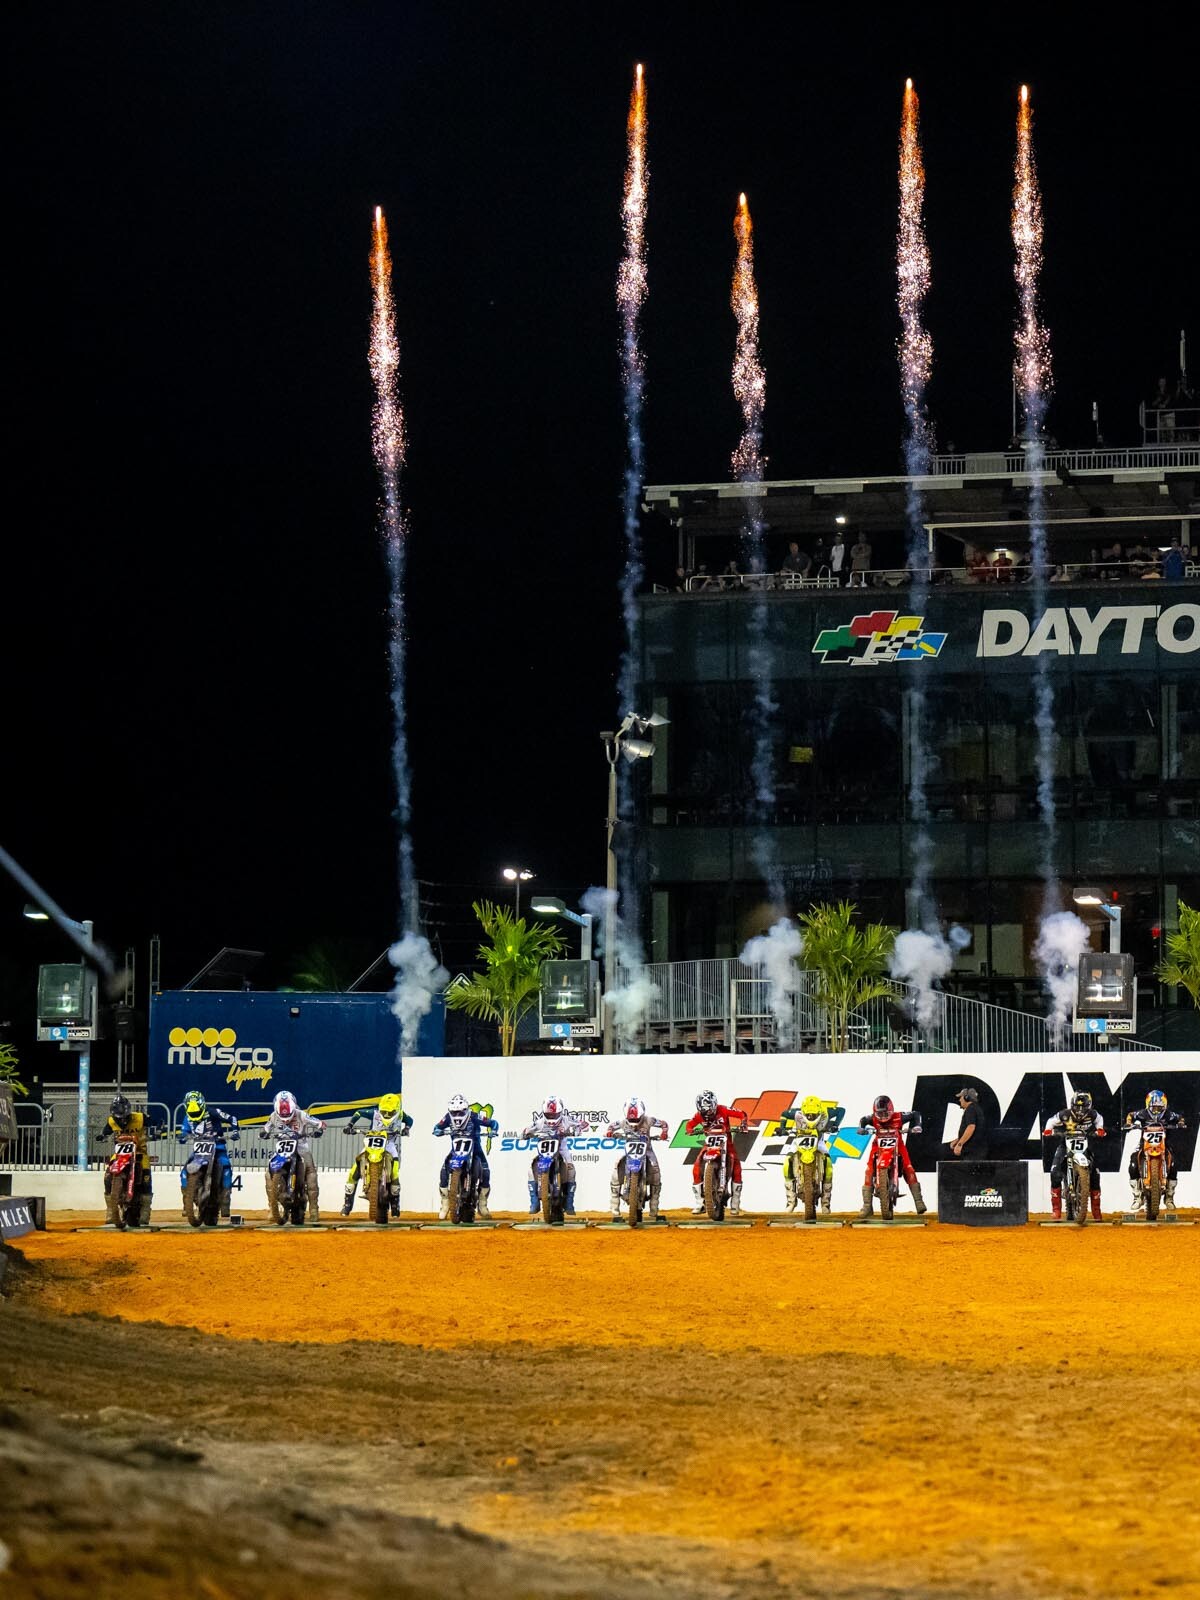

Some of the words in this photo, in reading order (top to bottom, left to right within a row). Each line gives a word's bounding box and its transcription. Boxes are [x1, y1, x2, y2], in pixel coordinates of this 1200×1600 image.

[367, 1137, 385, 1148] 19
[707, 1136, 725, 1147] 95
[799, 1137, 815, 1148] 41
[879, 1138, 897, 1148] 62
[1146, 1132, 1163, 1144] 25
[117, 1143, 134, 1154] 78
[278, 1141, 294, 1154] 35
[453, 1139, 472, 1153] 11
[540, 1140, 556, 1154] 91
[628, 1142, 645, 1155] 26
[1069, 1140, 1085, 1151] 15
[965, 1195, 1003, 1203] DAYTONA
[0, 1206, 31, 1229] KLEY
